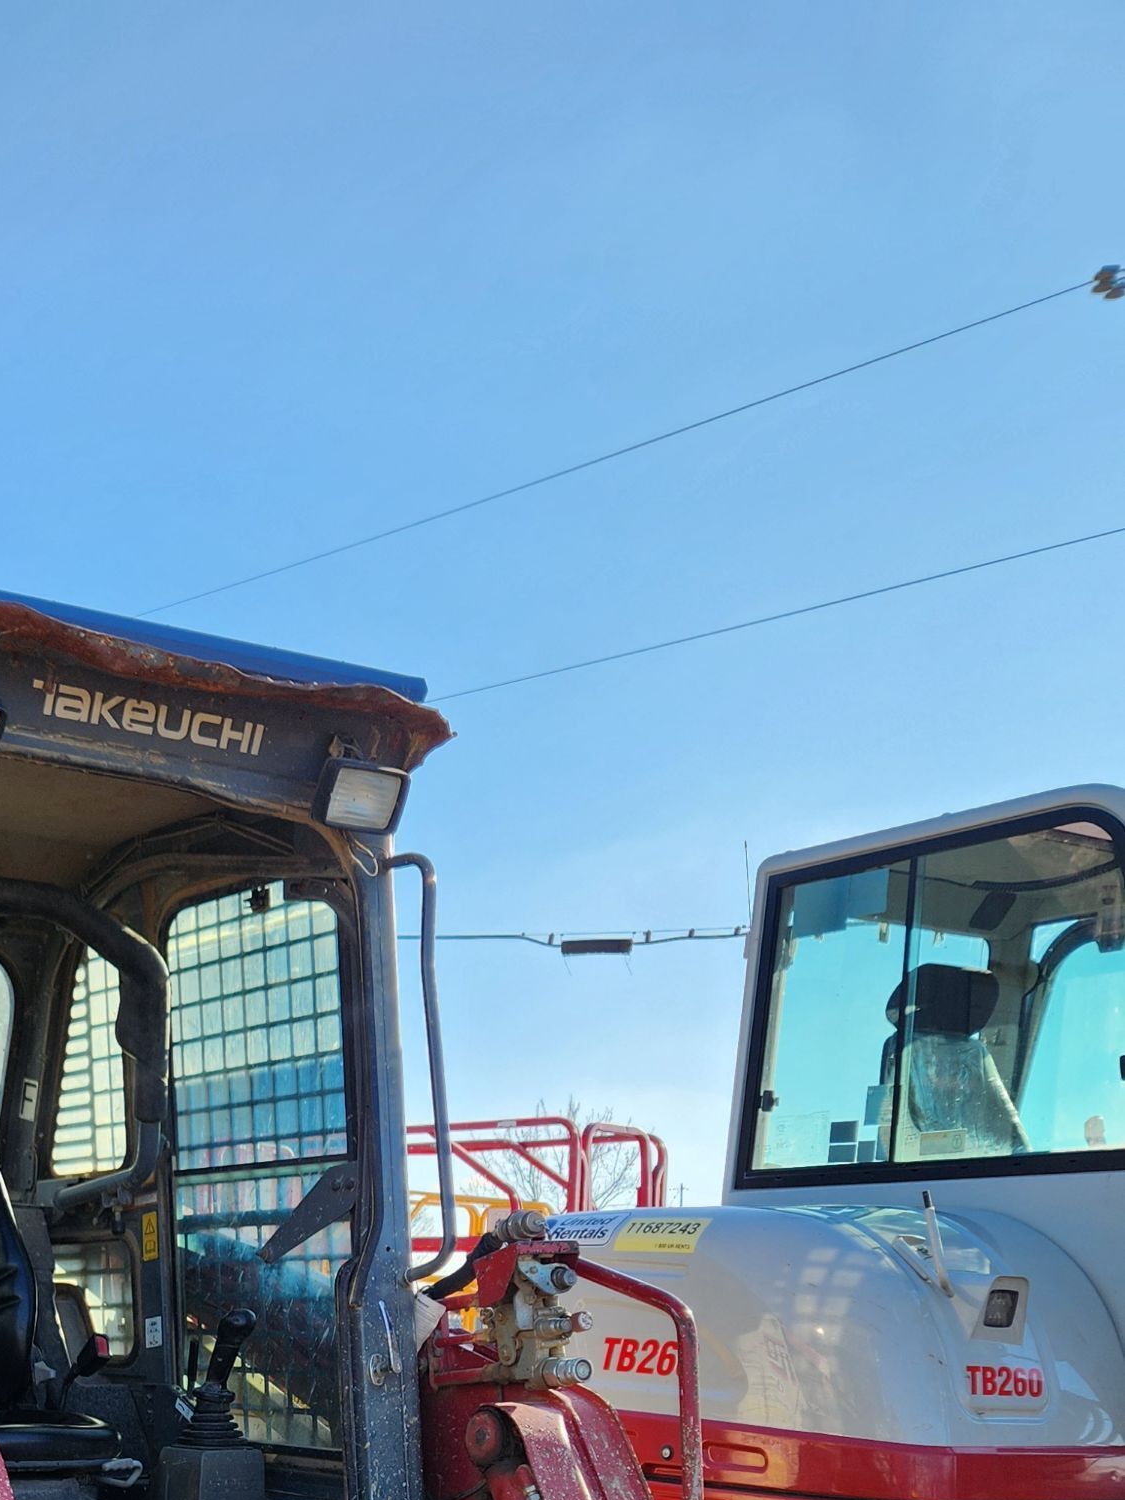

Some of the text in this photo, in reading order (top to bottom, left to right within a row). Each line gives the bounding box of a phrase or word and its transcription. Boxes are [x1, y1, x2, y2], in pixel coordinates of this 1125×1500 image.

[559, 1215, 618, 1226] United
[550, 1226, 610, 1240] Rentals
[626, 1222, 701, 1235] 11687243
[603, 1337, 678, 1377] TB26
[966, 1366, 1043, 1397] TB260
